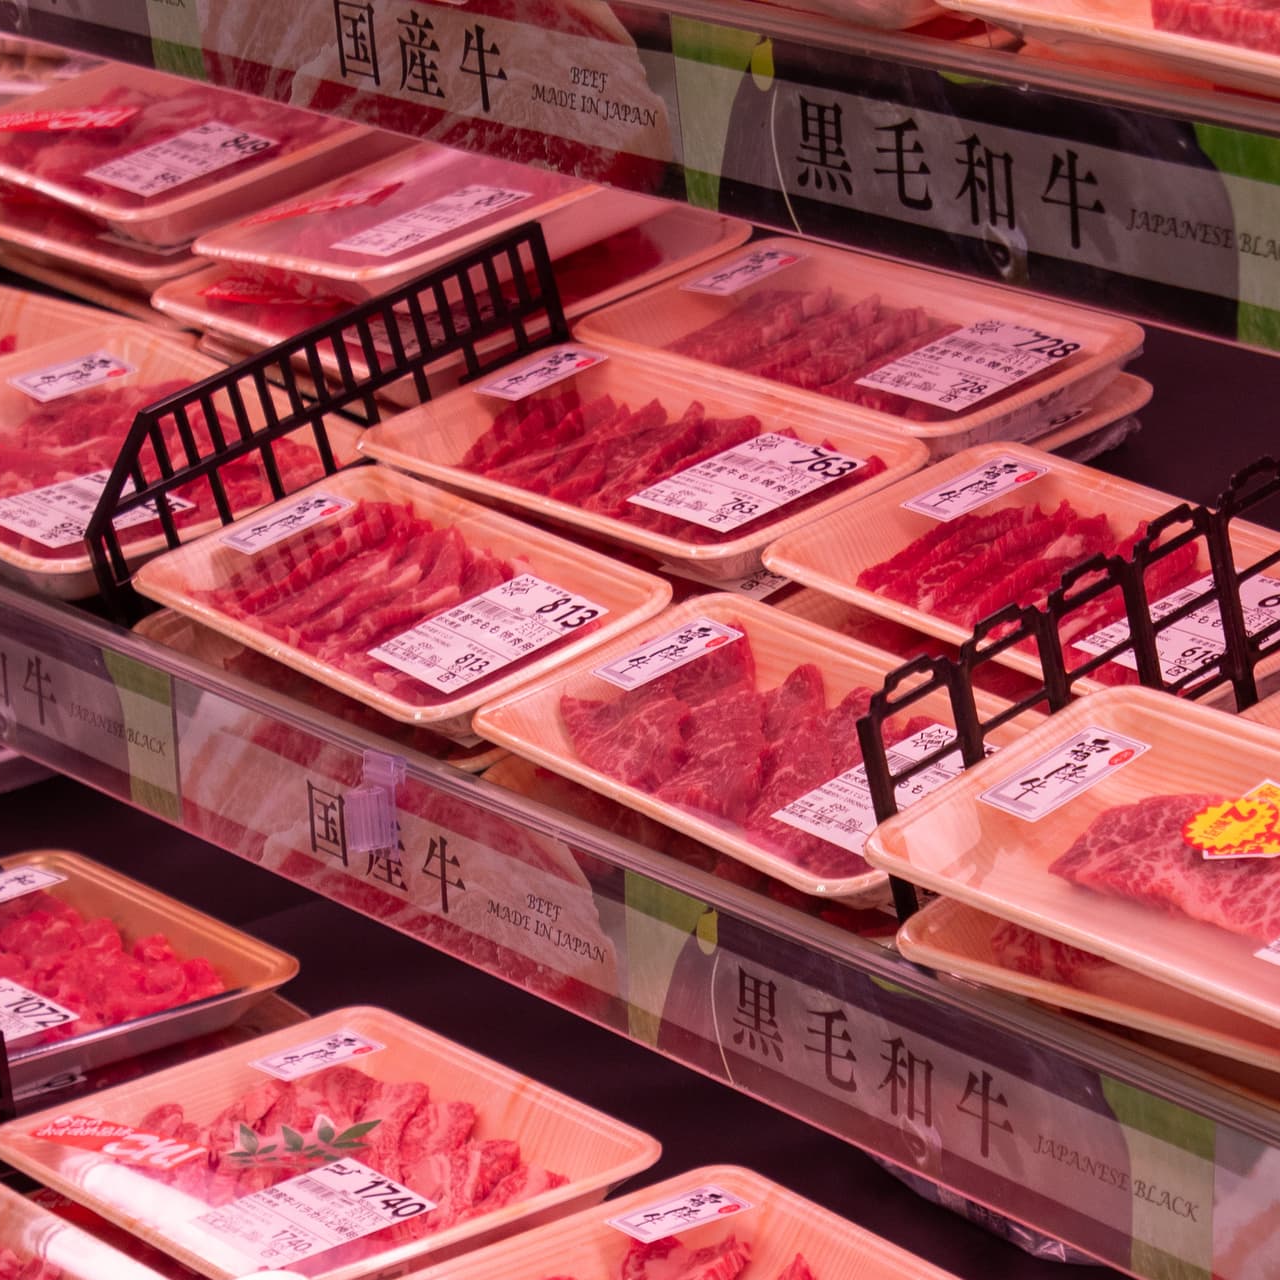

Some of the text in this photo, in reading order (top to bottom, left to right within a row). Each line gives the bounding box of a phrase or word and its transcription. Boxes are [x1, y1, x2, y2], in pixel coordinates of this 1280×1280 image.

[332, 2, 509, 112] 国産牛
[570, 65, 609, 94] BEEF
[531, 83, 659, 129] MADE IN JAPAN
[797, 95, 1106, 250] 黒毛和牛
[1125, 207, 1236, 251] JAPANESE
[1013, 331, 1081, 358] 728
[789, 448, 858, 477] 763
[721, 498, 759, 515] 763
[535, 597, 600, 629] 813
[455, 653, 490, 672] 813
[126, 725, 167, 757] BLACK
[526, 892, 563, 922] BEEF
[487, 900, 606, 966] MADE IN JAPAN
[5, 996, 71, 1027] 1072
[732, 965, 1016, 1159] 黒毛和牛
[1032, 1134, 1199, 1223] JAPANESE BLACK
[354, 1179, 427, 1219] 1740
[271, 1229, 313, 1251] 1740
